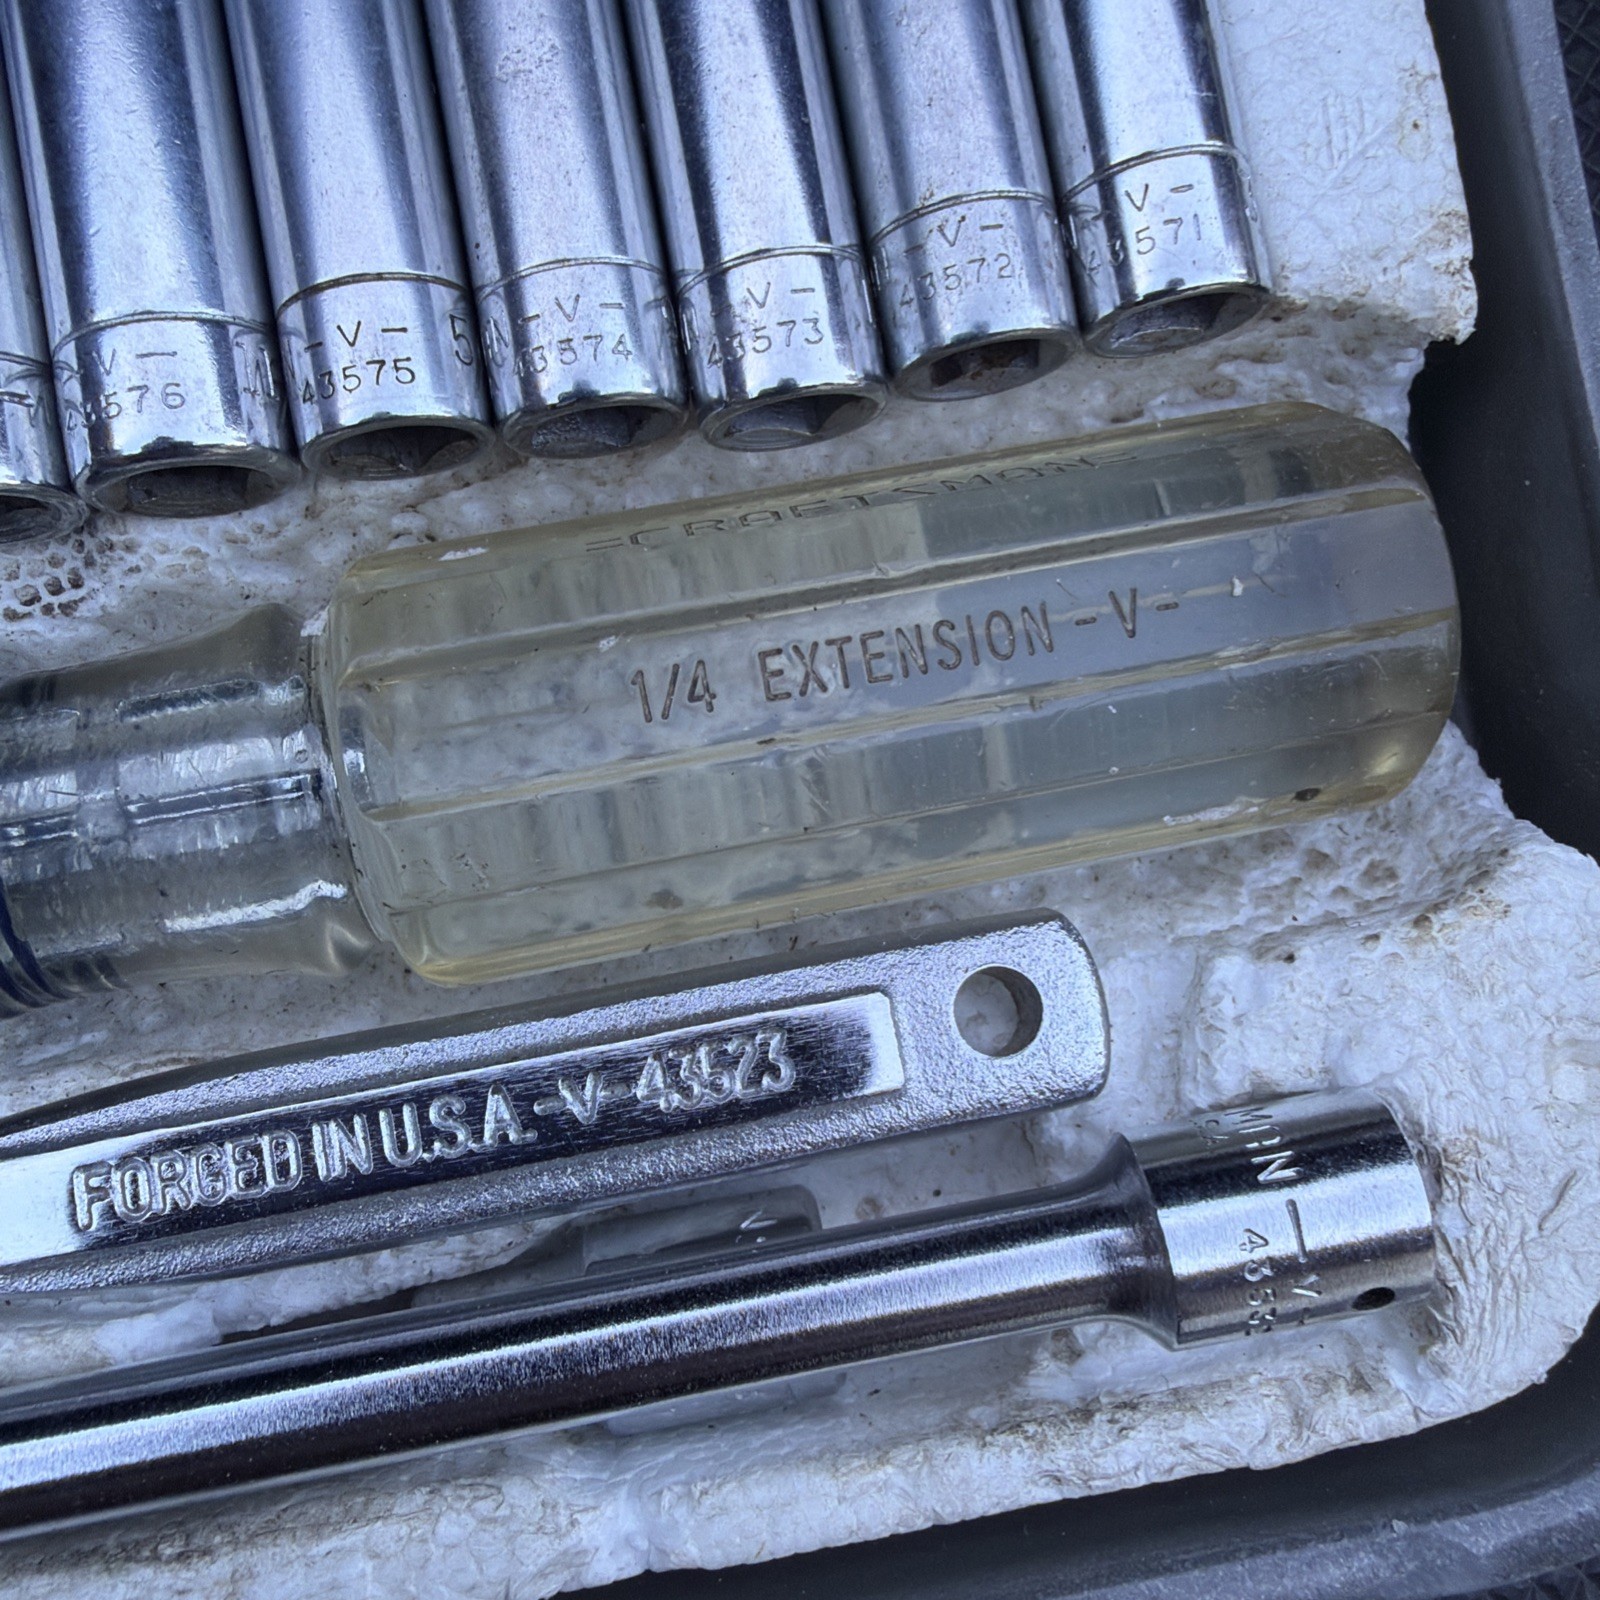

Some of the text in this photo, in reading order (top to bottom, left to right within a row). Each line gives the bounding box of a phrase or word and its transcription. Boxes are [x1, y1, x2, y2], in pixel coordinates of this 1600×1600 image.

[900, 252, 1013, 307] 43572
[302, 356, 417, 405] 43575
[629, 659, 718, 723] 1/4
[756, 600, 1056, 703] EXTENSION
[73, 1128, 304, 1231] FORGED
[311, 1112, 374, 1183] IN
